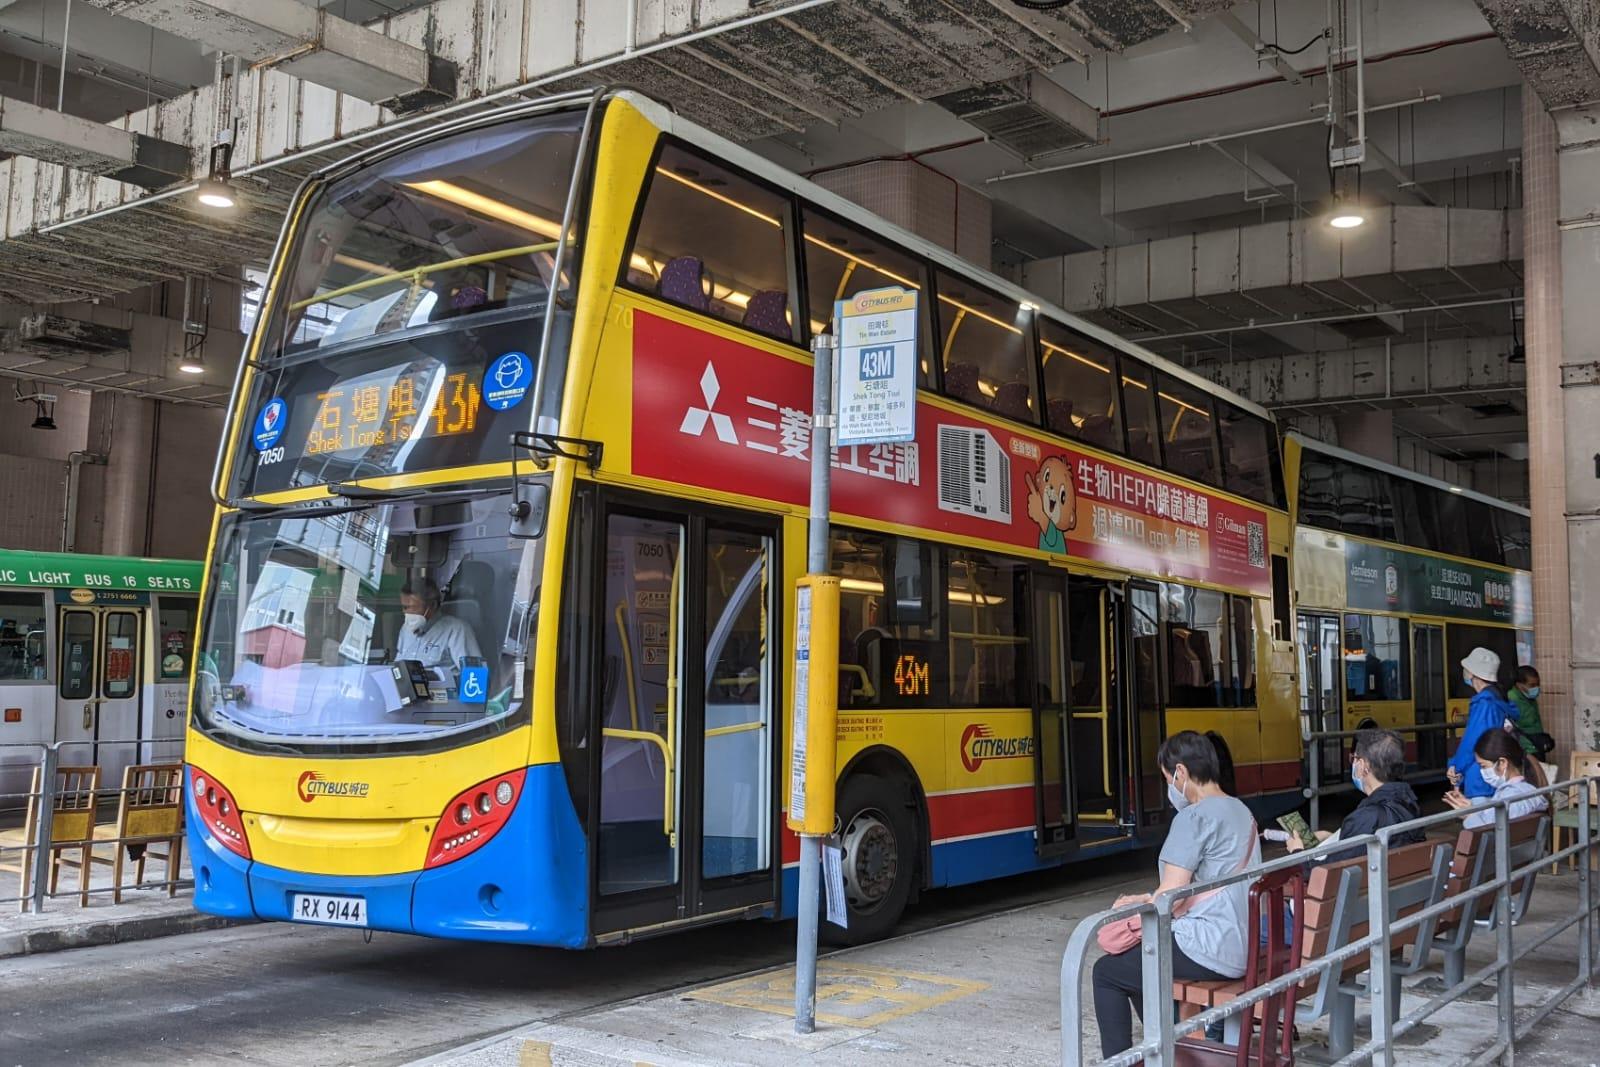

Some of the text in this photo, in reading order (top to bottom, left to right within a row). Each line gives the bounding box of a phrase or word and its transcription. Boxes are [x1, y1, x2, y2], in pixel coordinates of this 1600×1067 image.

[862, 349, 892, 377] 43M
[316, 378, 417, 430] 石塘咀
[853, 392, 868, 400] Shek
[869, 391, 886, 399] Tong
[308, 429, 343, 455] Shek
[347, 423, 386, 446] Tong
[746, 395, 920, 487] 三菱工空調
[258, 446, 285, 466] 7050
[637, 541, 664, 557] 7050
[29, 571, 72, 584] LIGHT
[84, 574, 112, 587] BUS
[122, 575, 138, 588] 16
[148, 577, 192, 590] SEATS
[895, 655, 929, 695] 43M
[972, 738, 1018, 757] CITYBUS
[307, 781, 348, 794] CITYBUS
[301, 896, 361, 921] RX 9144
